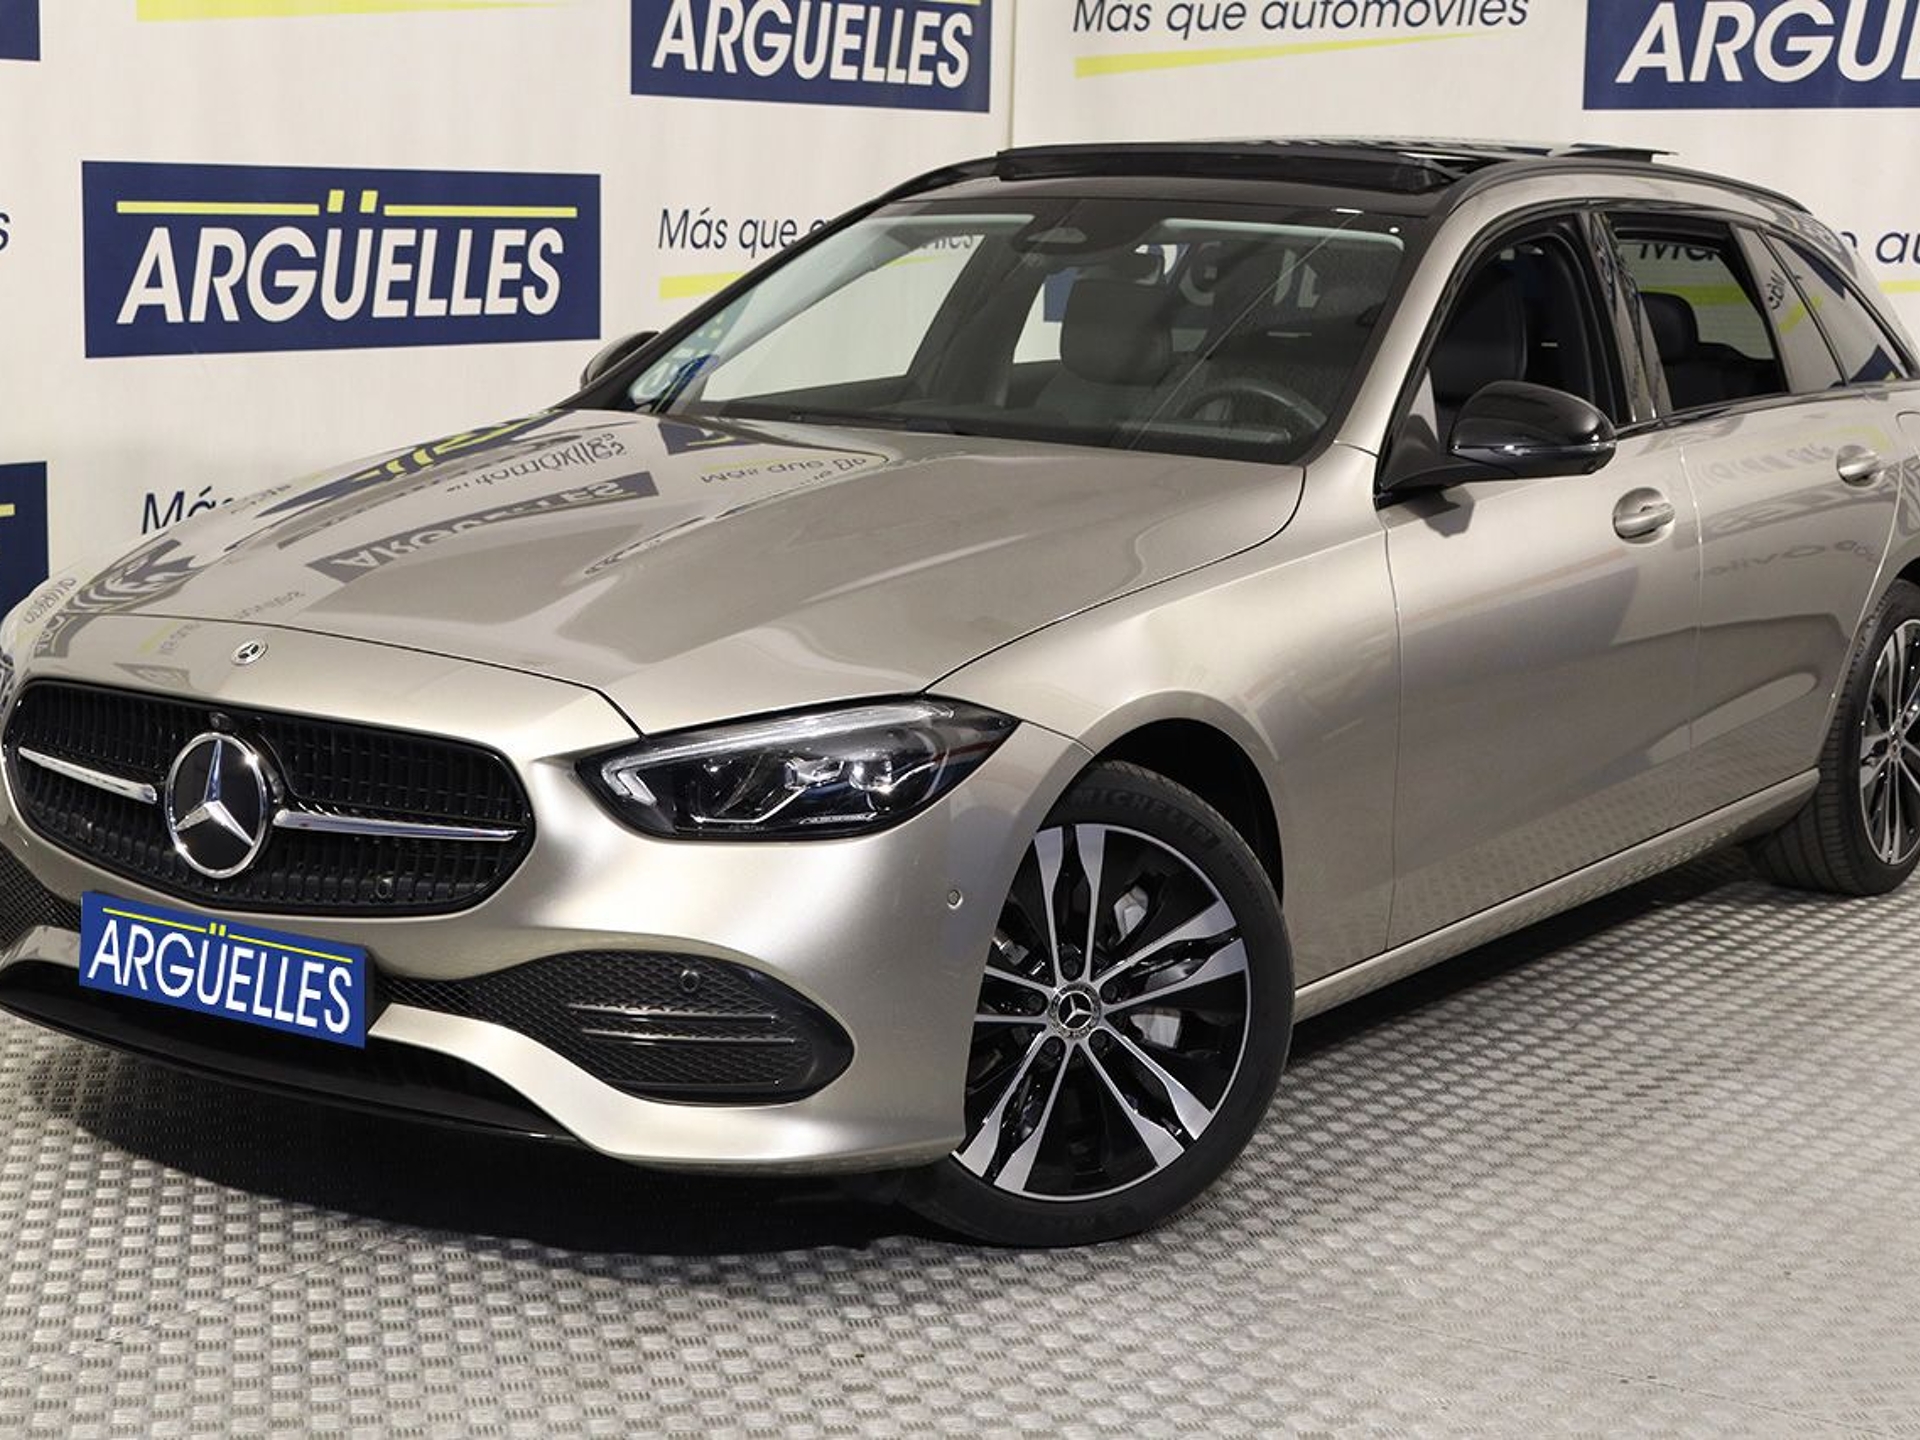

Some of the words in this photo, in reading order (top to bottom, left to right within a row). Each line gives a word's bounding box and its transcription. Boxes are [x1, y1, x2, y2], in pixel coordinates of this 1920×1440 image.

[1166, 2, 1247, 40] que
[116, 189, 564, 325] ARGÜELLES
[658, 207, 727, 249] Más
[739, 219, 797, 258] que
[87, 919, 353, 1034] ARGÜELLES
